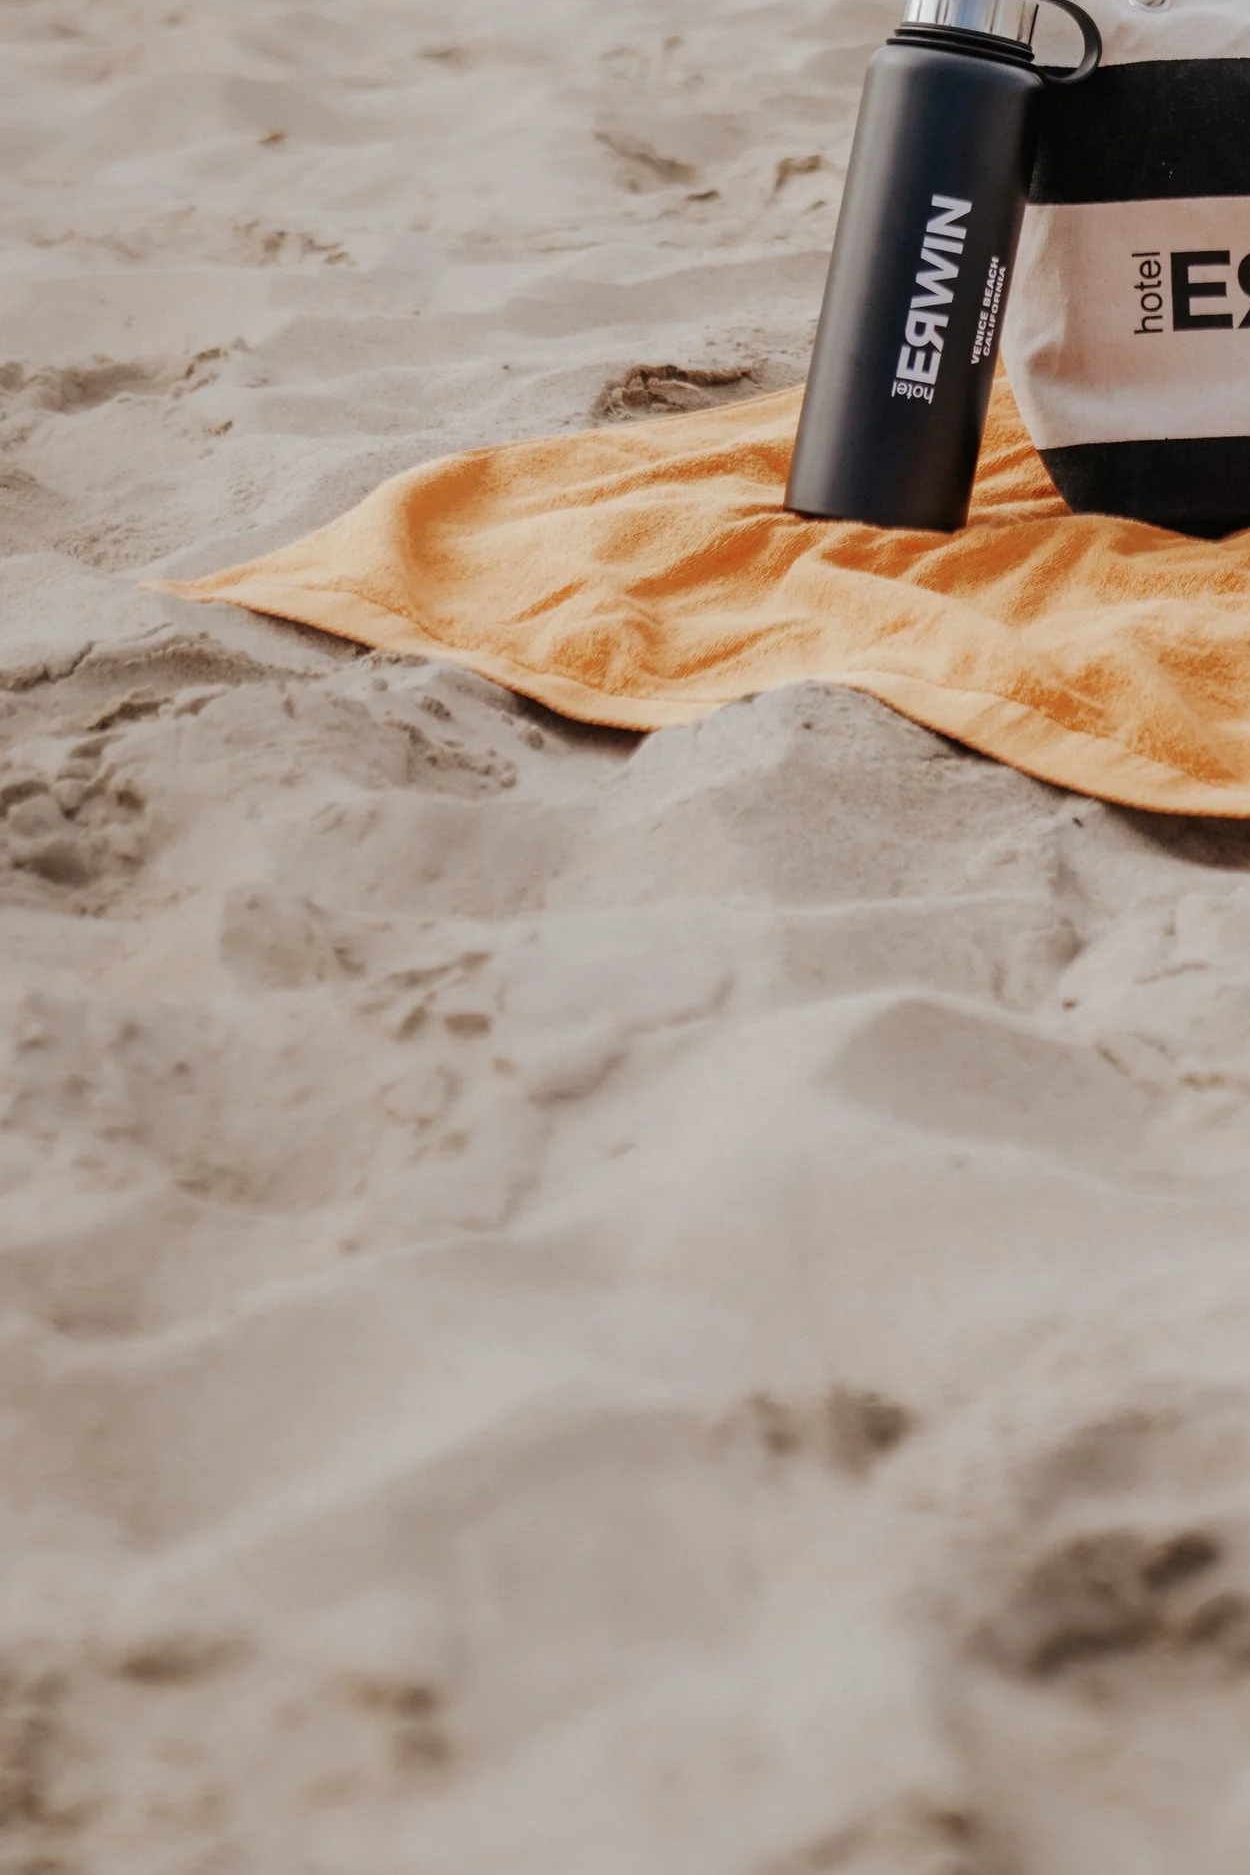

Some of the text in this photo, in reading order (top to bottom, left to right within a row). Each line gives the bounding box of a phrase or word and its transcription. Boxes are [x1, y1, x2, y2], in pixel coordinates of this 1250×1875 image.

[970, 256, 999, 365] VENICE BEACH
[983, 265, 1006, 357] CALIFORNIA
[1131, 251, 1163, 334] hotel
[891, 379, 934, 405] hotel
